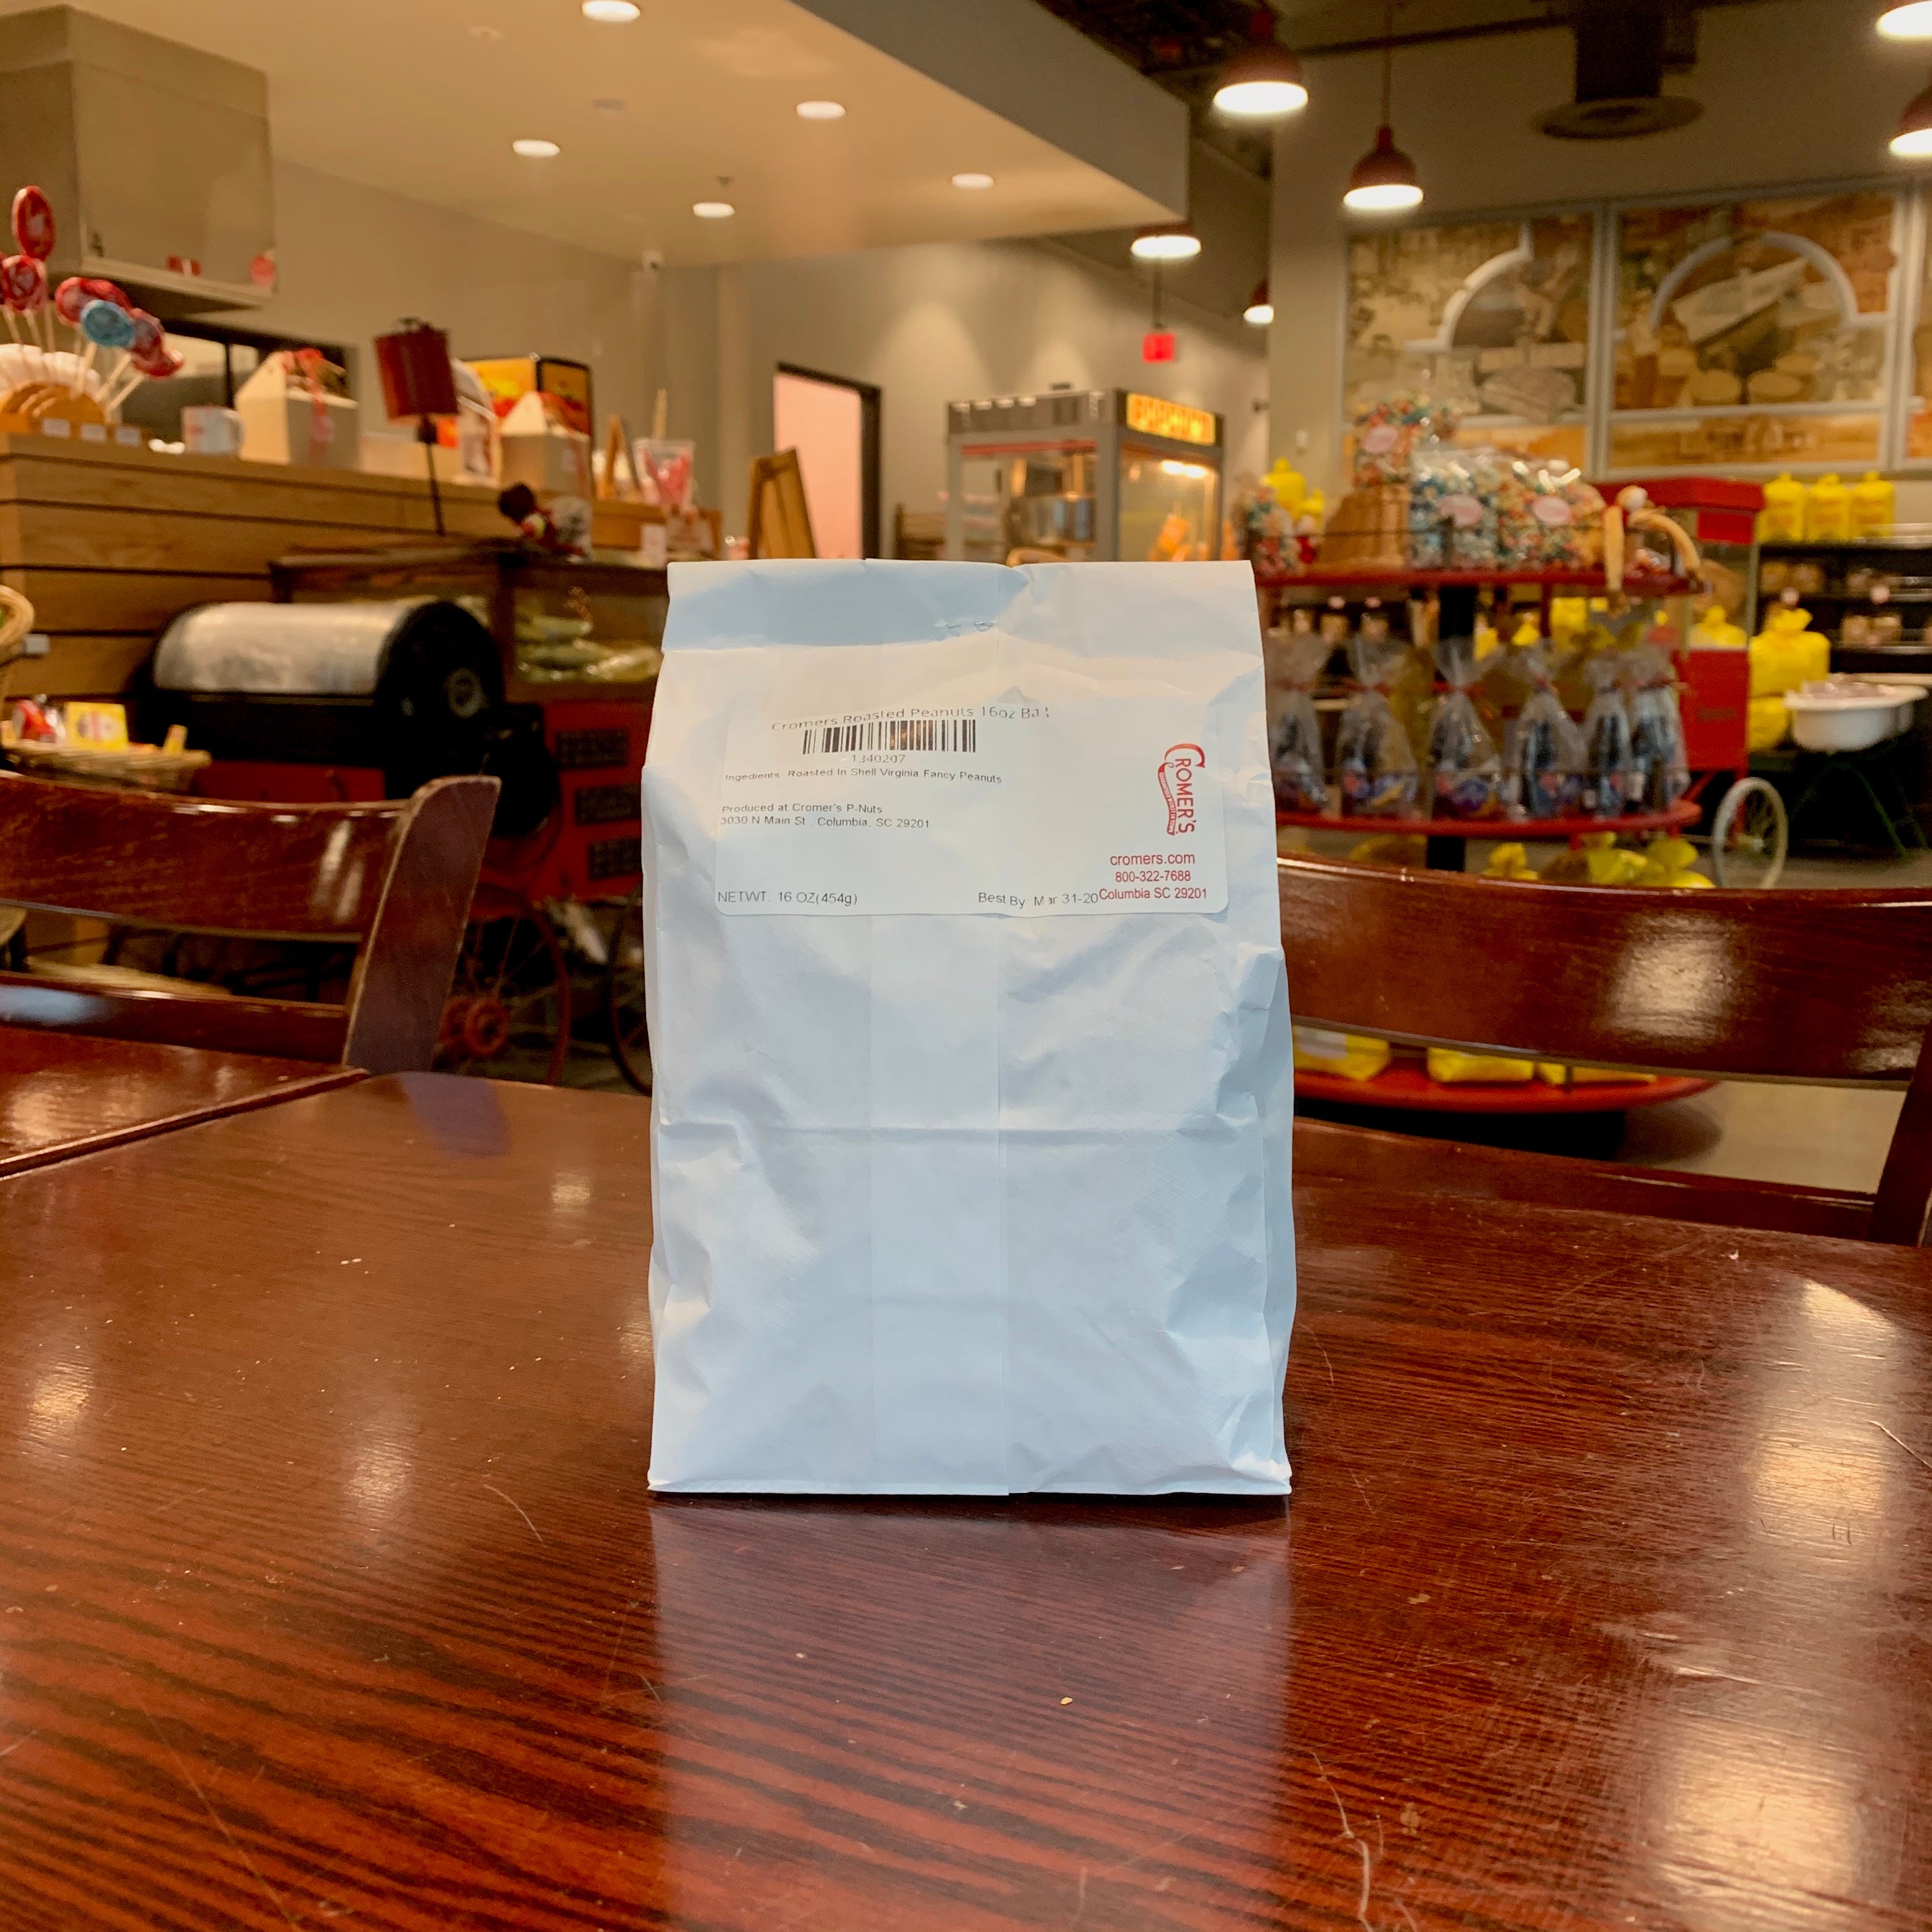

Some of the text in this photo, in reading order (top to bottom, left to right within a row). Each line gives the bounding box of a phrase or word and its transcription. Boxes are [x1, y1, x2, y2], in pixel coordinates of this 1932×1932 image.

[771, 717, 838, 731] Cromers
[843, 709, 905, 723] Roasted
[910, 707, 974, 717] Peanuts
[981, 706, 1015, 719] 16oz
[852, 754, 906, 763] 1340207
[788, 768, 833, 777] Roasted
[850, 768, 877, 776] Shell
[880, 768, 919, 779] Virginia
[923, 769, 956, 781] Fancy
[960, 771, 1002, 784] Peanuts
[1163, 743, 1206, 834] CROMER'S
[721, 803, 883, 813] Produced at Cromer's P-Nuts
[720, 816, 748, 825] 3030
[751, 816, 760, 824] N
[764, 816, 790, 825] Main
[875, 818, 893, 827] SC
[896, 818, 930, 828] 29201
[1109, 853, 1196, 865] cromers.com
[1115, 870, 1192, 882] 800-322-7688
[778, 891, 792, 902] 16
[977, 892, 1006, 904] Best
[1062, 893, 1099, 904] 31-20
[1098, 886, 1208, 900] Columbia SC 29201
